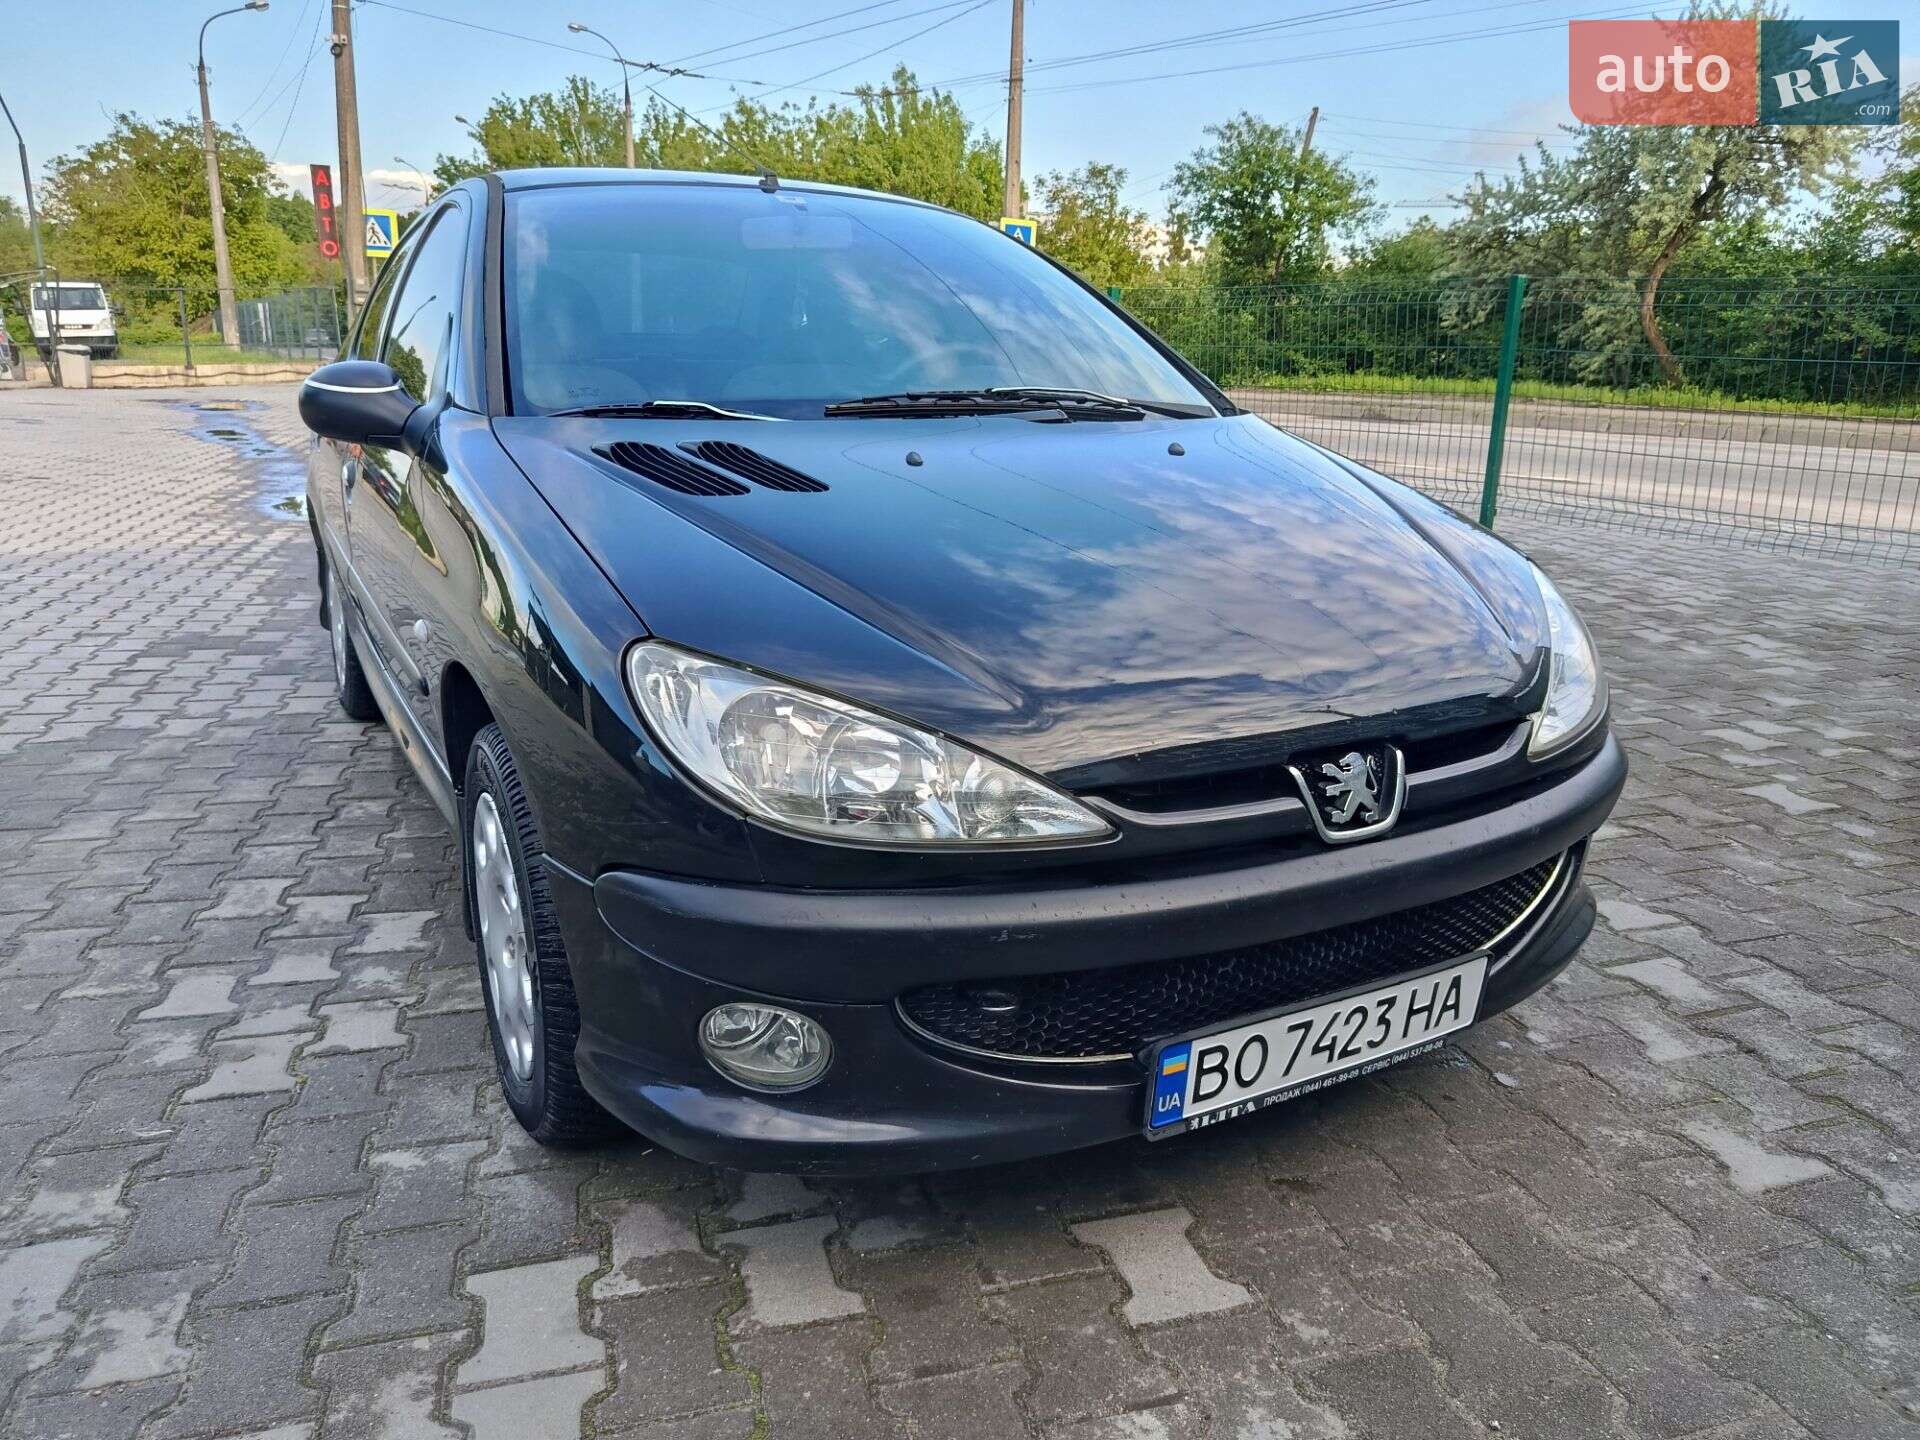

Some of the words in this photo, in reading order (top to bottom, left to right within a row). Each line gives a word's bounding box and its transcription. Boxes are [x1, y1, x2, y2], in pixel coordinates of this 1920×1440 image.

[315, 168, 339, 257] АВТО
[1191, 1034, 1270, 1104] BO
[1281, 996, 1398, 1078] 7423
[1402, 974, 1462, 1039] HA
[1158, 1092, 1181, 1112] UA
[1263, 1086, 1301, 1107] ПРОДАЖ
